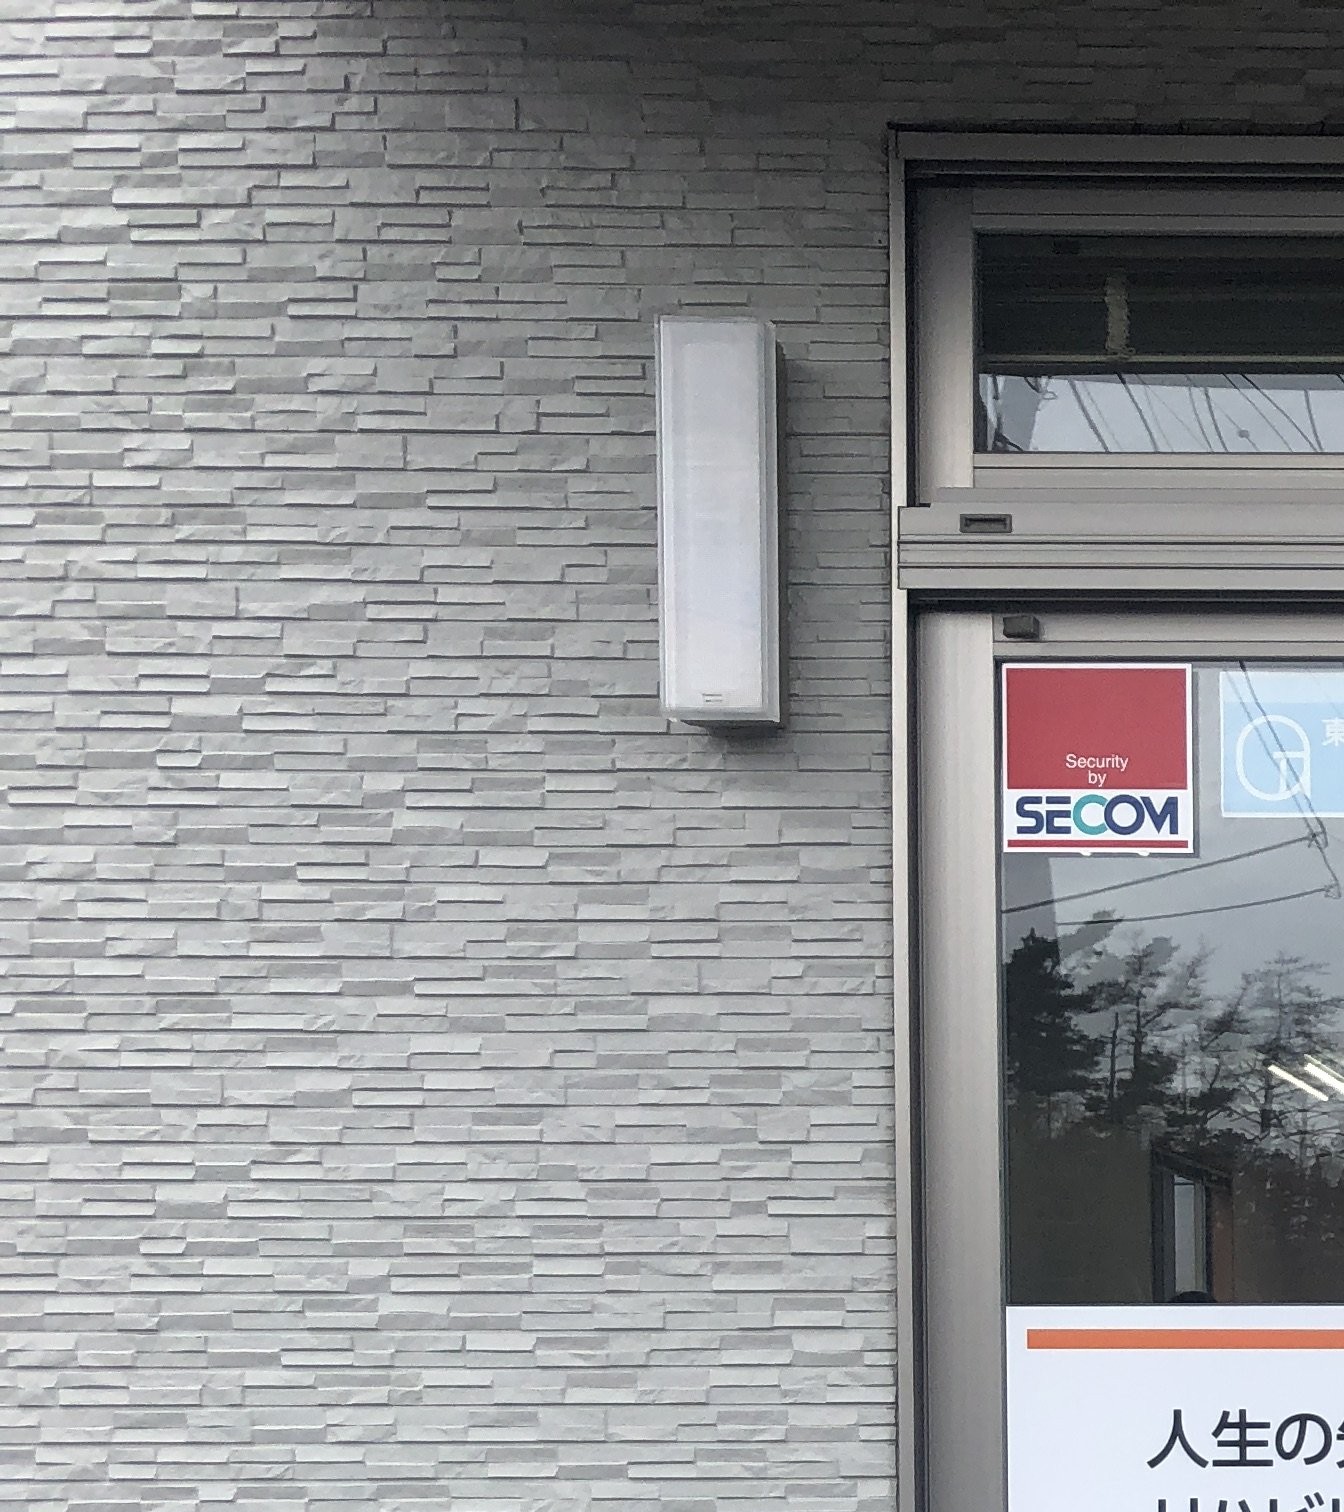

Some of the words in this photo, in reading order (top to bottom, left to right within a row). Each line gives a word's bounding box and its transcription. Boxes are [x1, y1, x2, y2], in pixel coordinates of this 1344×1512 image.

[1065, 753, 1129, 771] Security
[1088, 770, 1107, 787] by
[1015, 793, 1179, 836] SECOM
